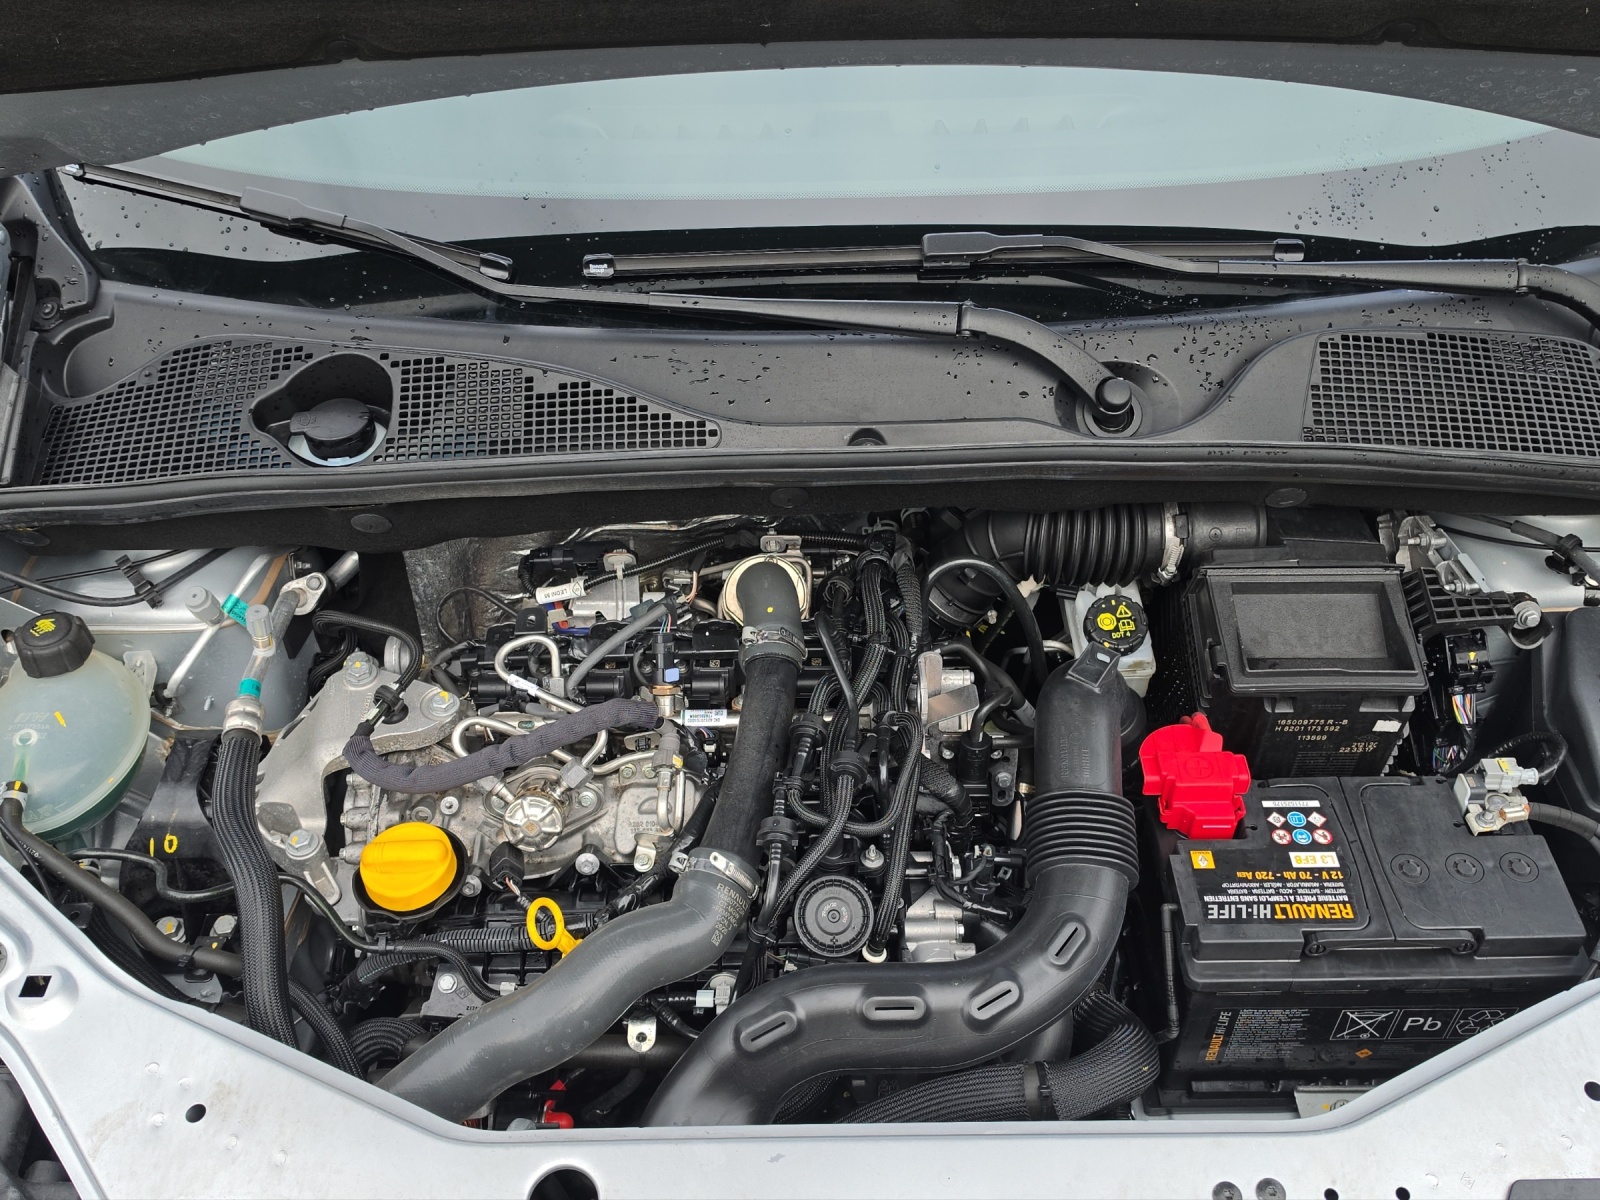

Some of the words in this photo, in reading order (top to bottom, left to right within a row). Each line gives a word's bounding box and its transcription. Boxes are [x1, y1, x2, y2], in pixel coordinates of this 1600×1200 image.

[1255, 871, 1274, 879] 720
[1283, 871, 1296, 879] Ah
[1298, 871, 1312, 879] 70
[1322, 872, 1330, 880] V
[1331, 872, 1344, 880] 12
[716, 882, 748, 911] RENAULT
[1274, 903, 1354, 919] RENAULT
[1402, 1016, 1442, 1032] Pb
[1205, 1034, 1224, 1061] RENAULT
